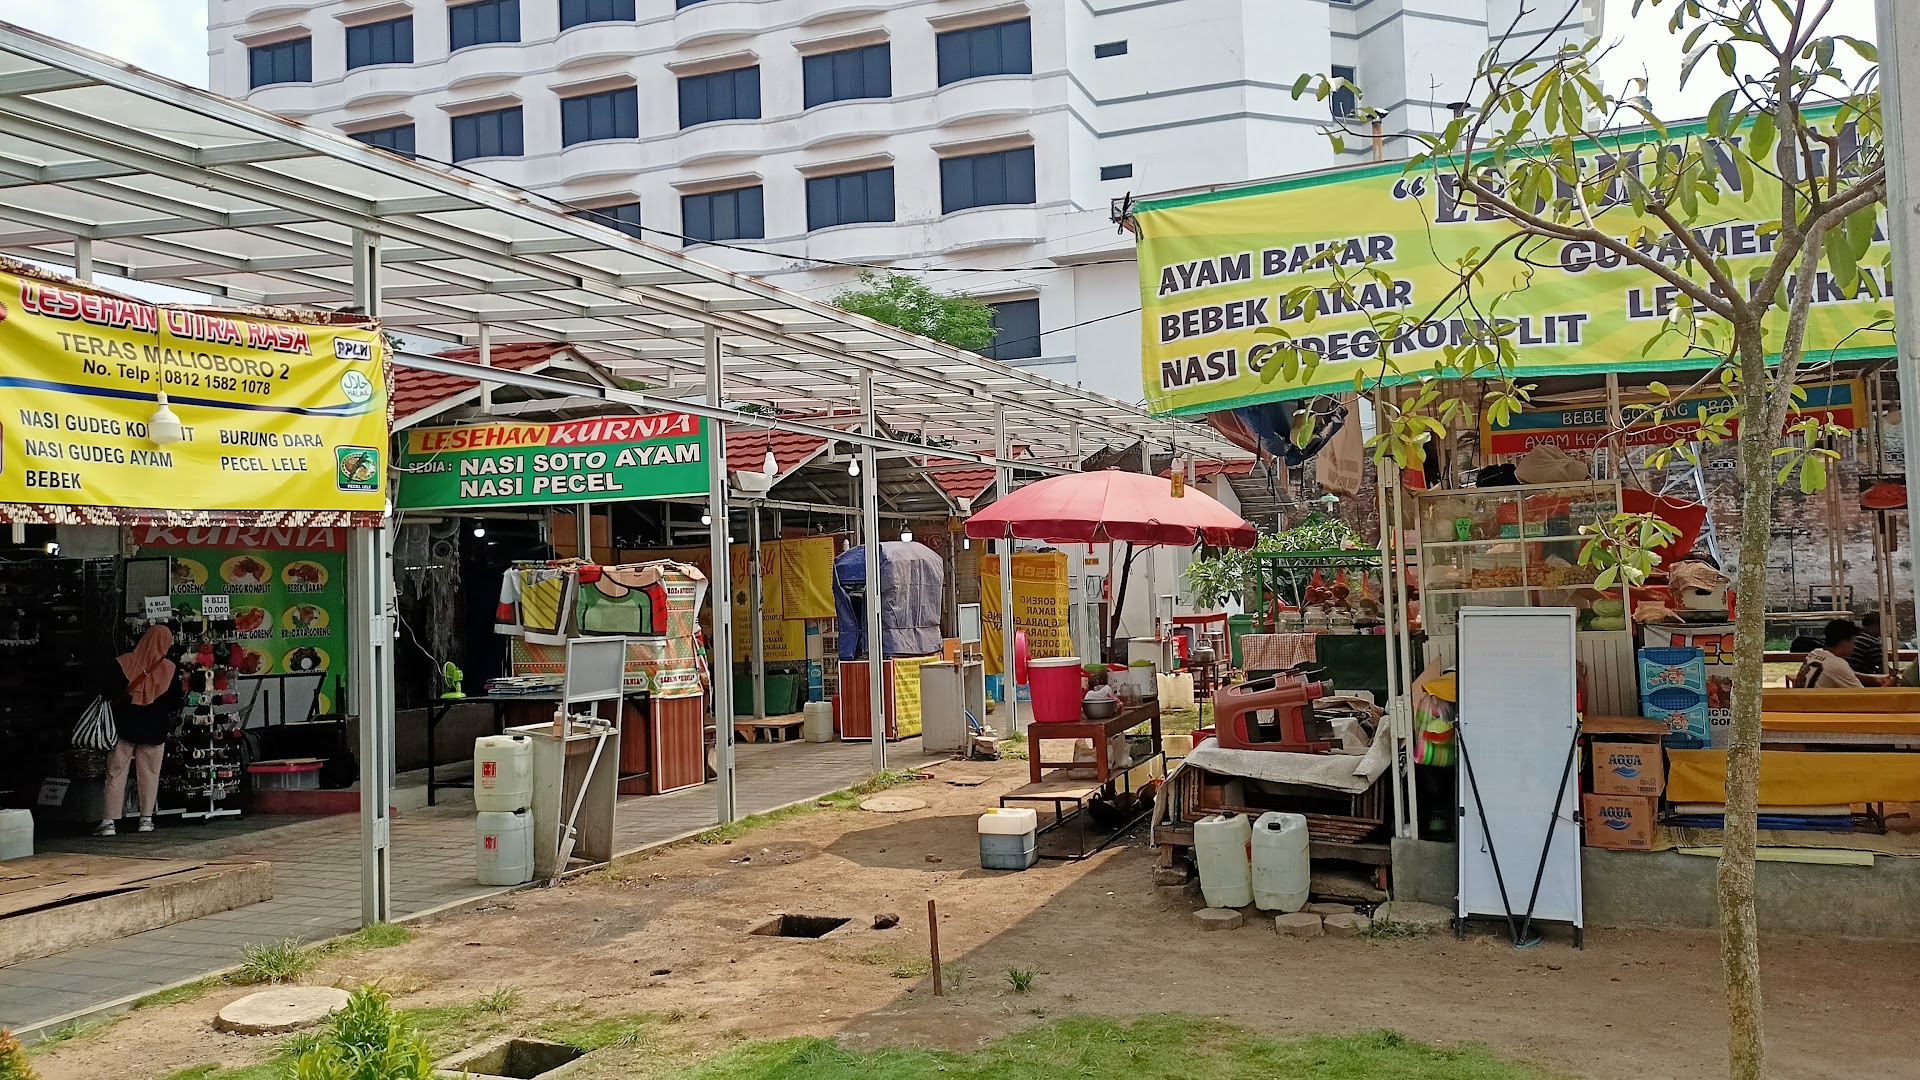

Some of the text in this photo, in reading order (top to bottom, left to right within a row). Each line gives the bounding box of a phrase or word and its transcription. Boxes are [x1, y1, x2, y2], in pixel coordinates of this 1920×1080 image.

[1159, 235, 1394, 295] AYAM BAKAR
[19, 280, 311, 355] LESEHAN CITRA RASA
[1161, 280, 1411, 342] BEBEK BAKAR
[57, 331, 290, 380] TERAS MALIOBORO 2
[1162, 349, 1236, 389] NASI
[83, 359, 111, 376] No.
[118, 363, 150, 384] Telp
[165, 370, 199, 387] 0812
[204, 375, 236, 391] 1582
[242, 379, 270, 395] 1078
[19, 409, 194, 442] NASI GUDEG KOIT
[1562, 409, 1608, 425] BEBE
[220, 429, 324, 448] BURUNG DARA
[421, 414, 690, 451] LESEHAN KURNIA
[1525, 432, 1570, 448] AYAM
[25, 439, 173, 467] NASI GUDEG AYAM
[221, 456, 308, 471] PECEL LELE
[408, 460, 446, 474] SEDIA
[460, 455, 525, 477] NASI
[533, 451, 608, 472] SOTO
[614, 443, 701, 468] AYAM
[26, 470, 82, 490] BEBEK
[460, 472, 624, 498] NASI PECEL
[1608, 754, 1643, 767] AQUA
[1599, 806, 1632, 819] AQUA
